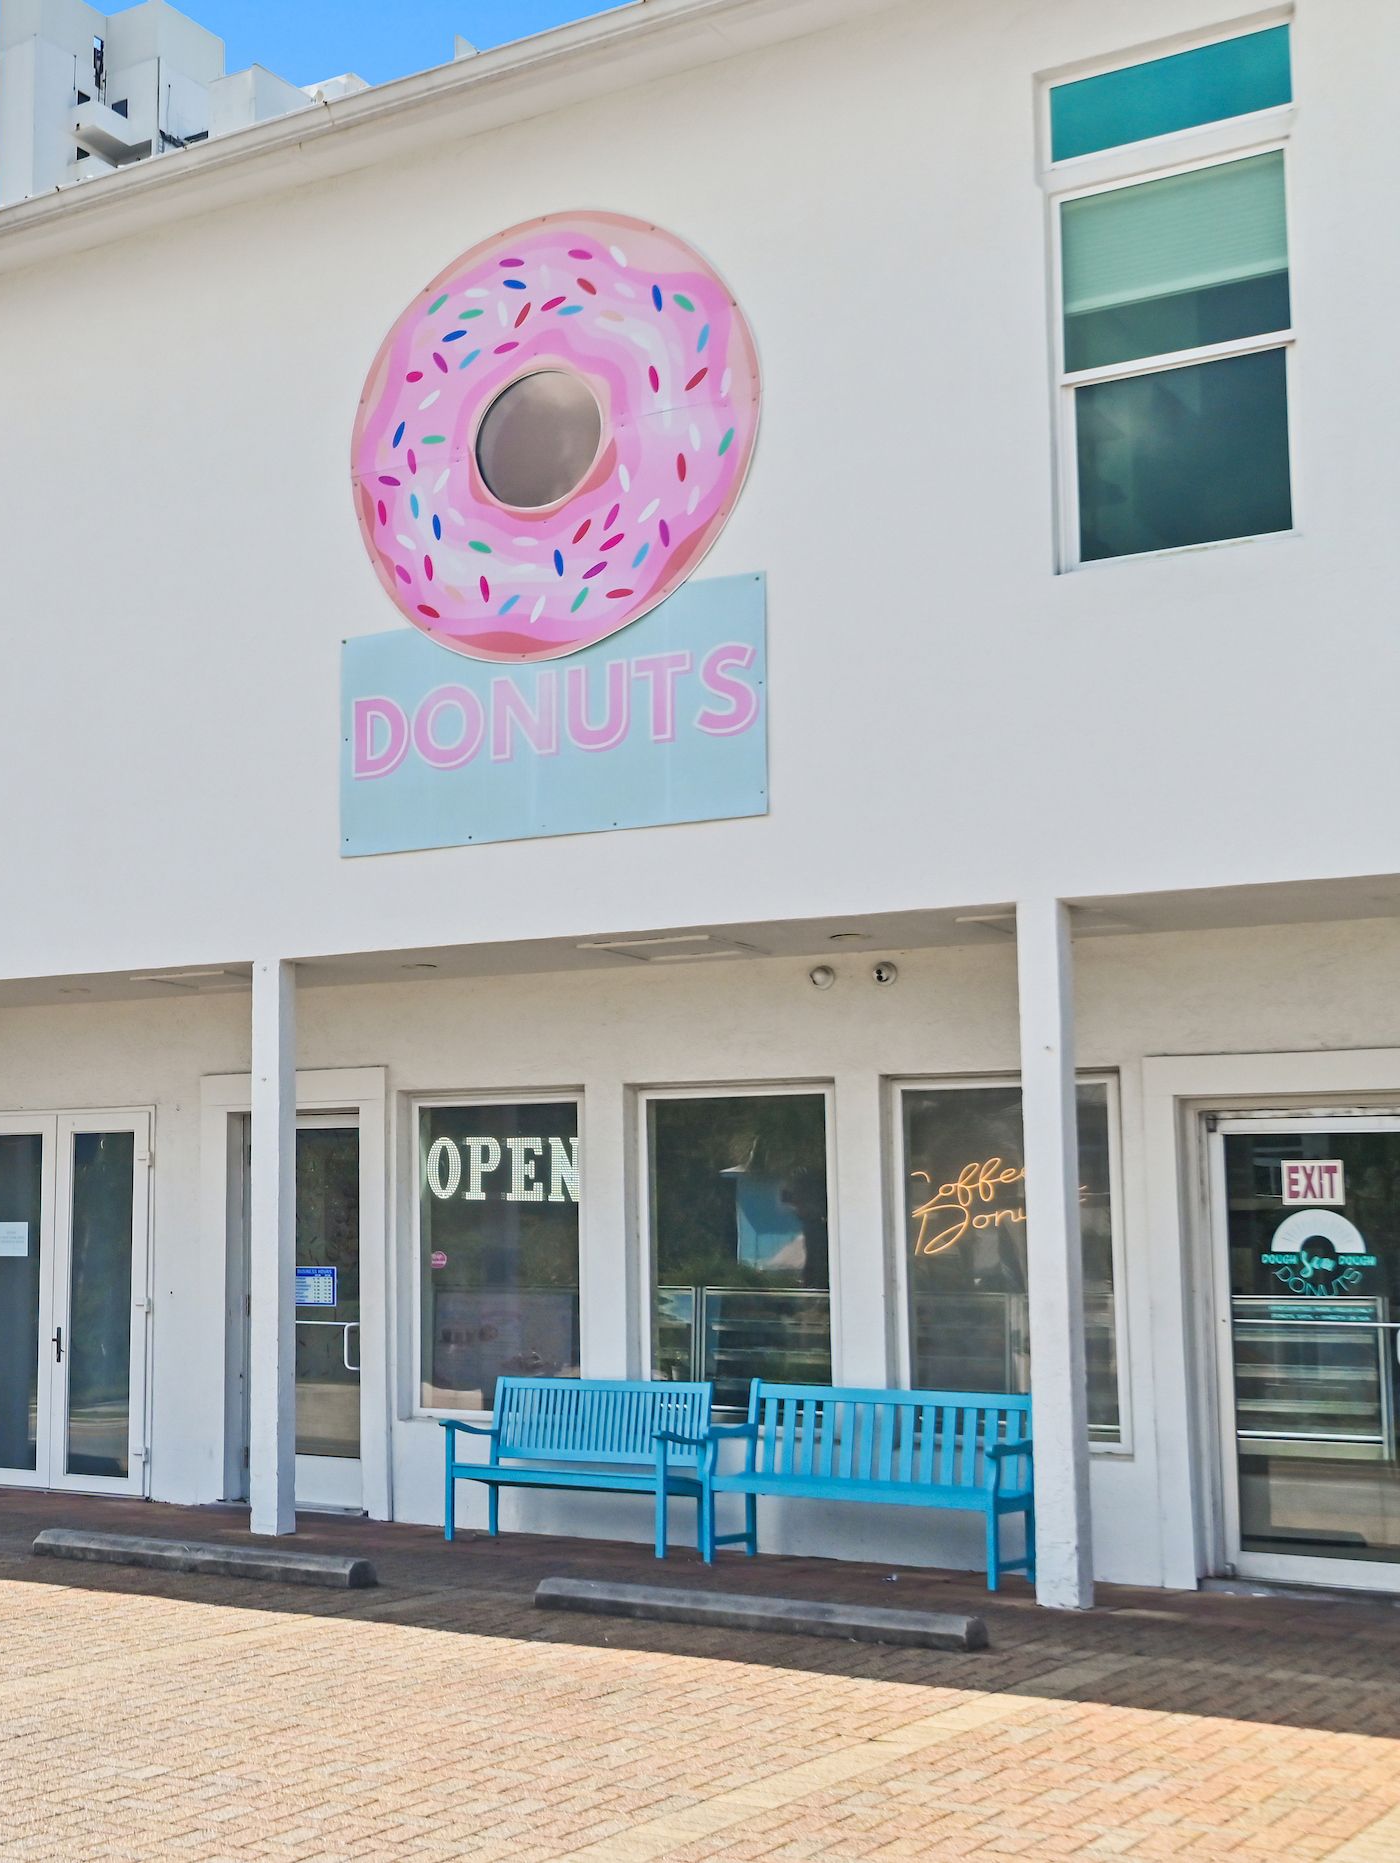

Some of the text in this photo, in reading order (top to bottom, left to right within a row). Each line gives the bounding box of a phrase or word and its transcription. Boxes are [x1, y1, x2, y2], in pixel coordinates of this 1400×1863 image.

[352, 642, 758, 780] DONUTS
[427, 1136, 580, 1202] OPEN
[1286, 1165, 1337, 1199] EXIT
[1261, 1253, 1299, 1265] DOUGH
[1338, 1255, 1378, 1267] DOUGH
